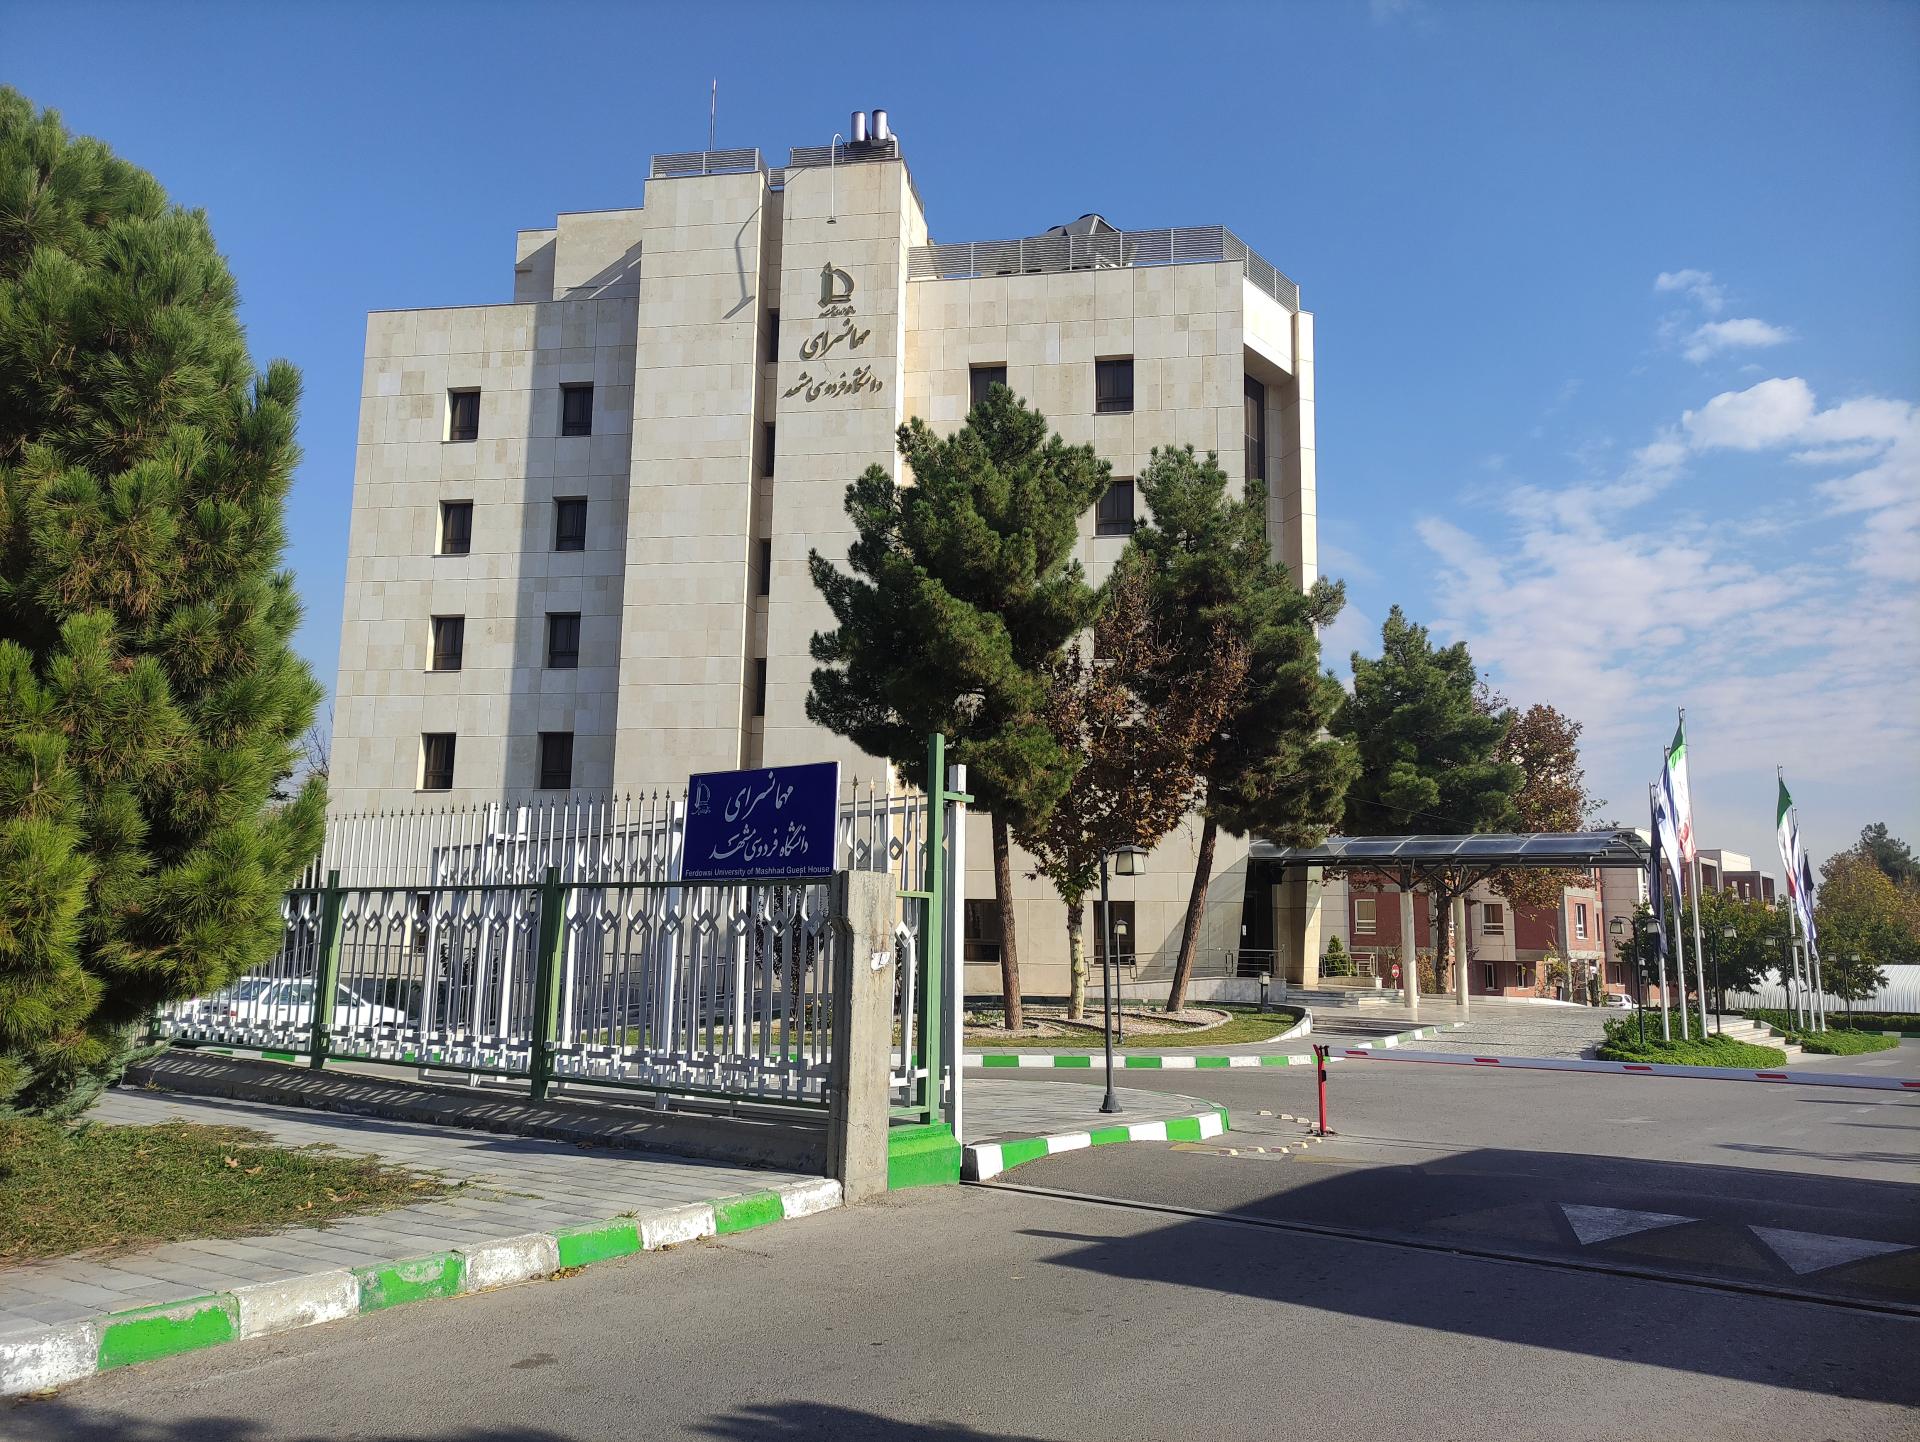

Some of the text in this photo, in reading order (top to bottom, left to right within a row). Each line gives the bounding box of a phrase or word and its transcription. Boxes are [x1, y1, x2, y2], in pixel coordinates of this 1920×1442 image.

[780, 371, 813, 400] مشهد
[709, 821, 809, 861] دانشگاه فردوسی مشهد
[685, 865, 830, 877] Ferdowsi University of Mashhad Guest House
